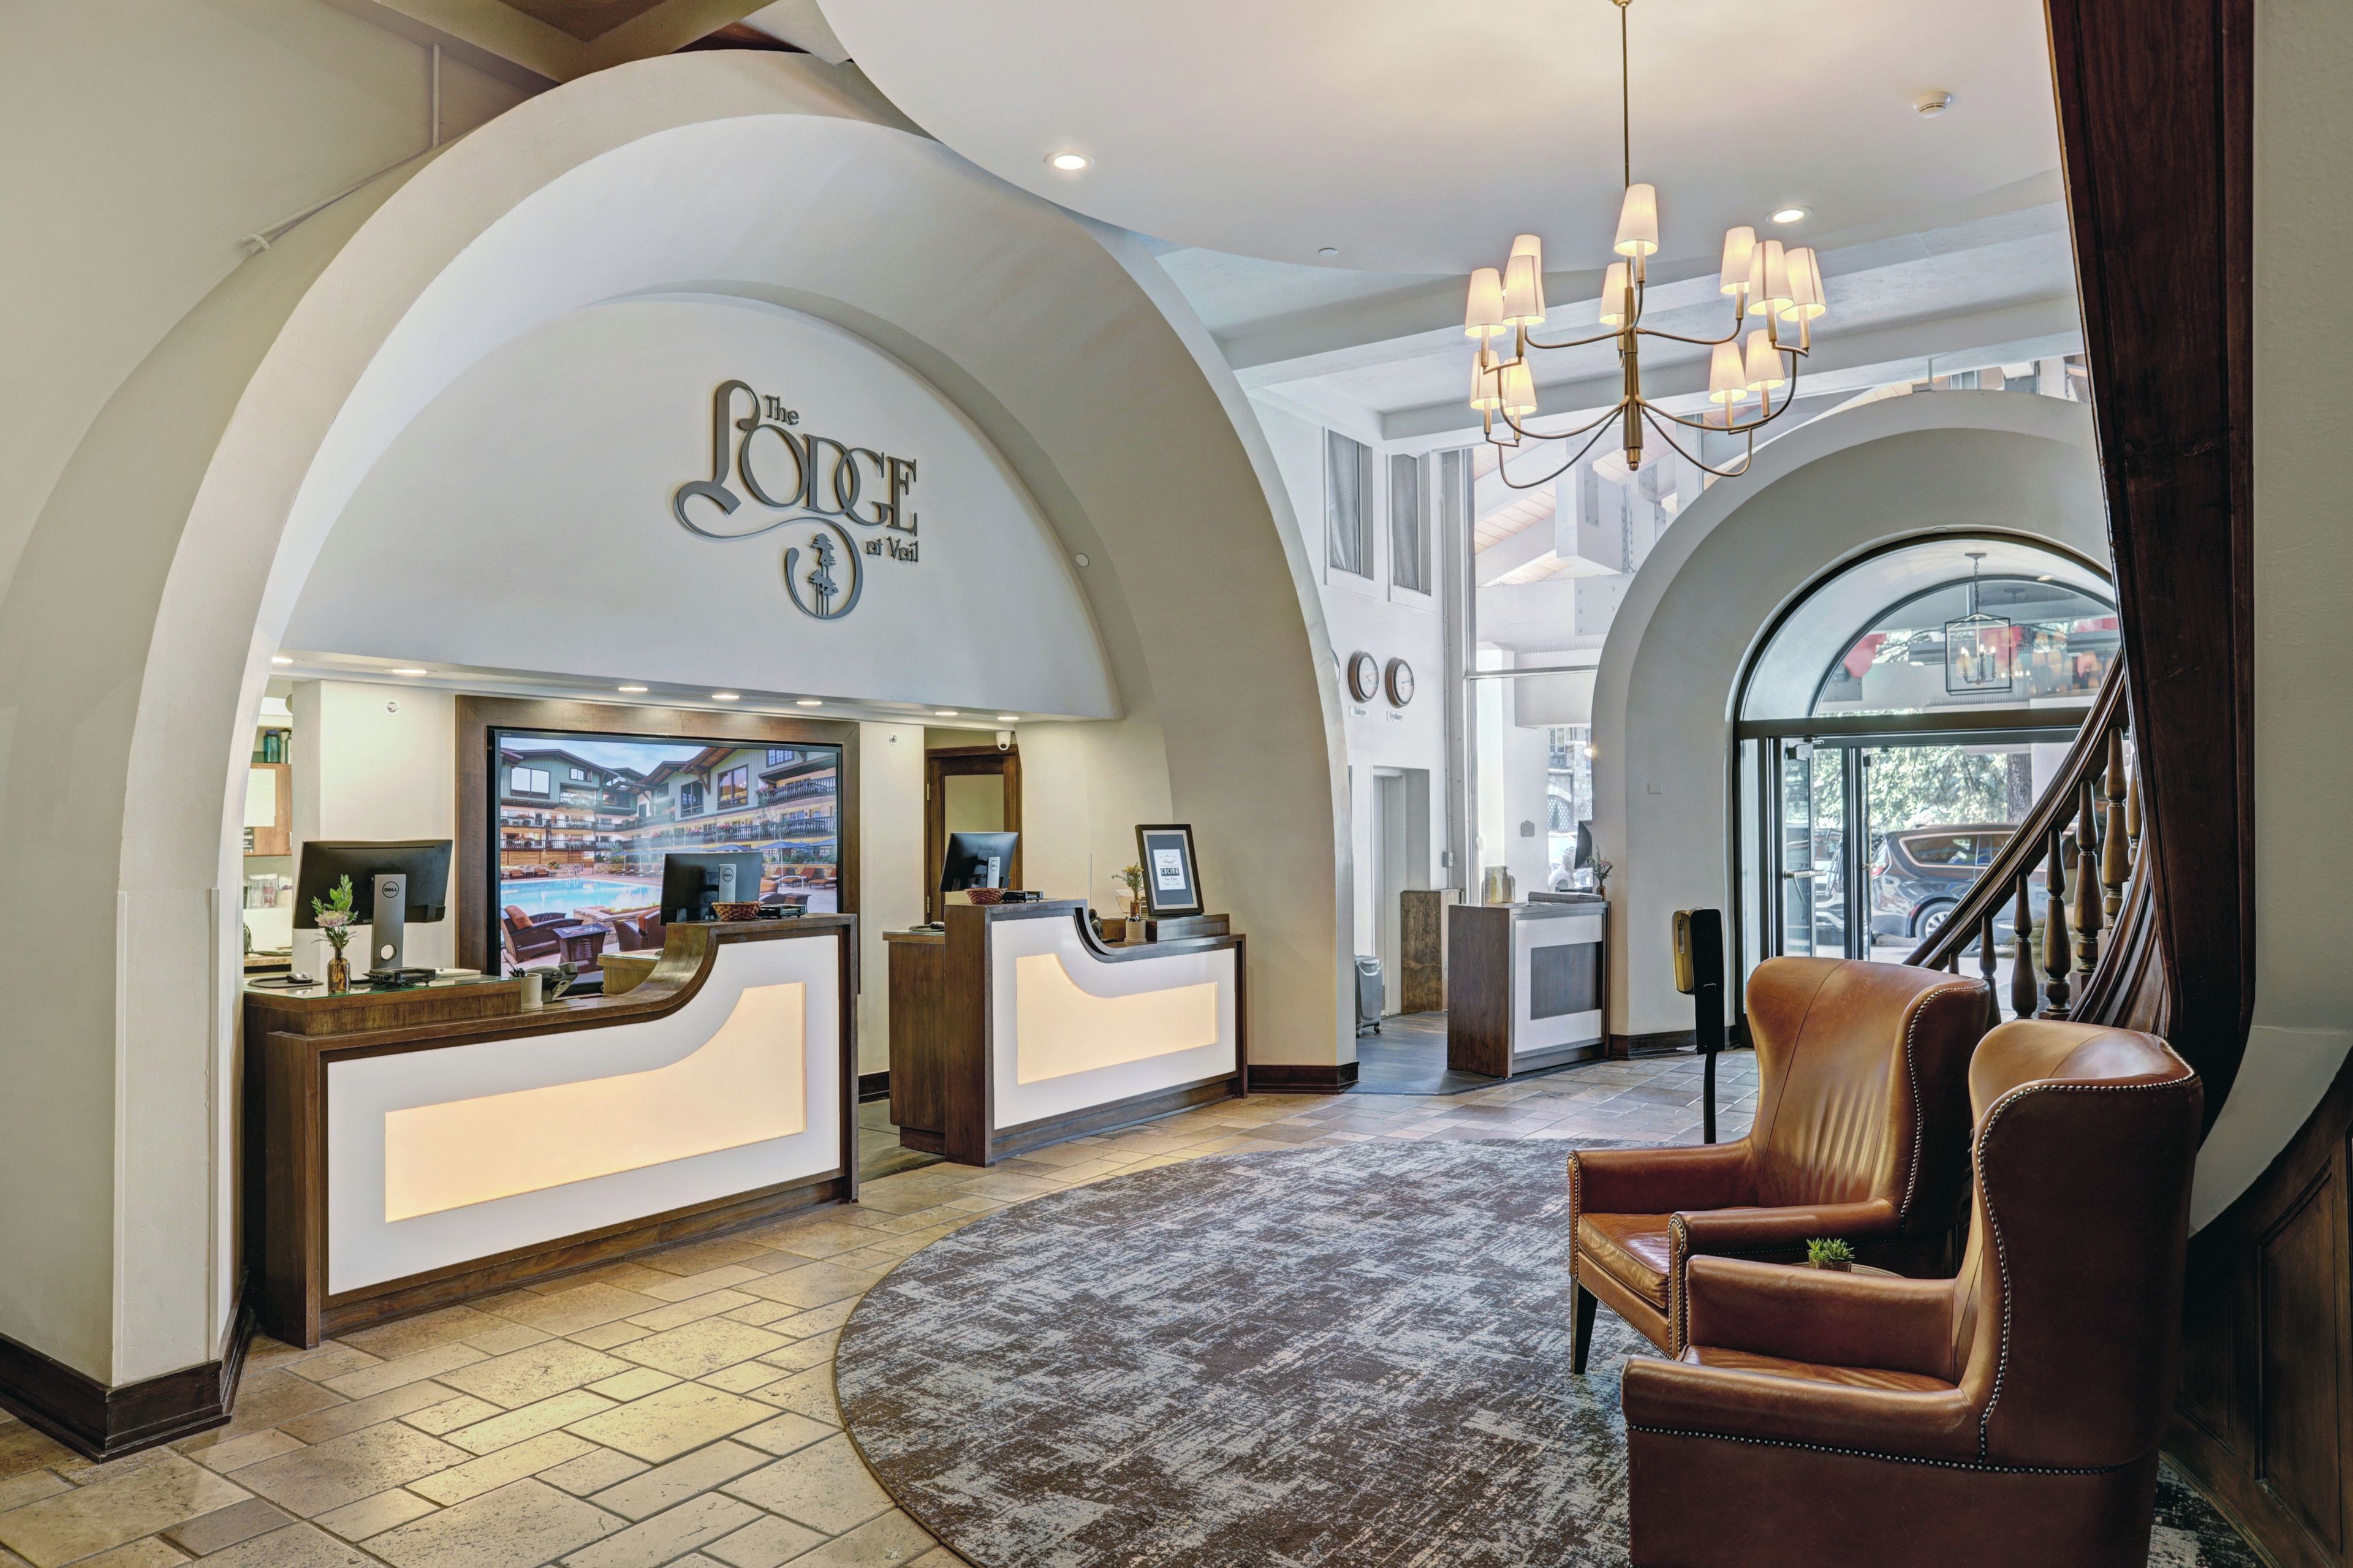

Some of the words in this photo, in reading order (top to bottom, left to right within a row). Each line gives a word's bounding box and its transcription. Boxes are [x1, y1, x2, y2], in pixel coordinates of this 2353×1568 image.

[765, 395, 799, 425] The
[674, 379, 917, 538] LODGE
[866, 538, 883, 556] at
[887, 536, 919, 562] Vail
[1354, 706, 1366, 718] Tokyo
[1389, 711, 1403, 722] Sydney
